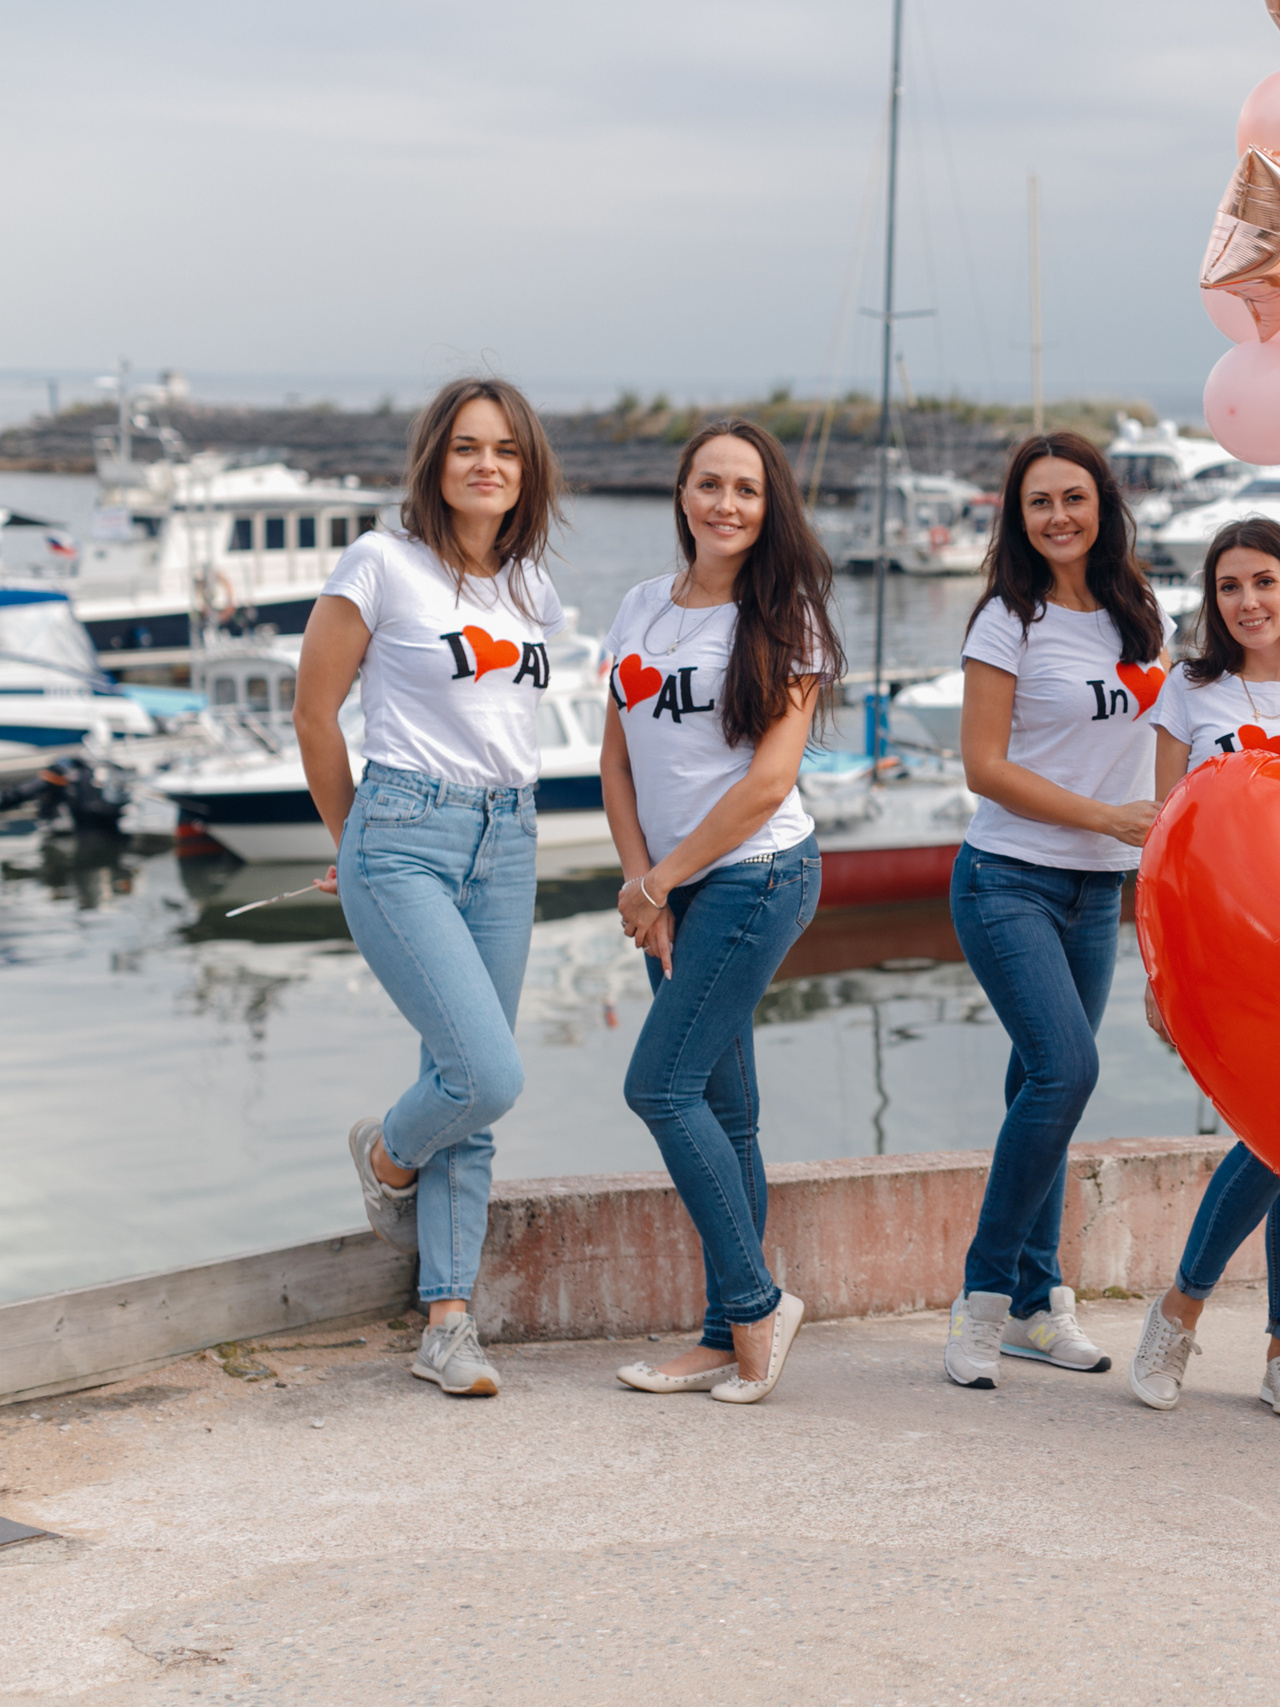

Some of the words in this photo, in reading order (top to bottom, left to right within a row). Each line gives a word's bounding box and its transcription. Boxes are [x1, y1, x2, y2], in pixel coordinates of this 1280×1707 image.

[440, 631, 475, 680] I
[652, 666, 715, 724] AL
[1086, 679, 1128, 721] In
